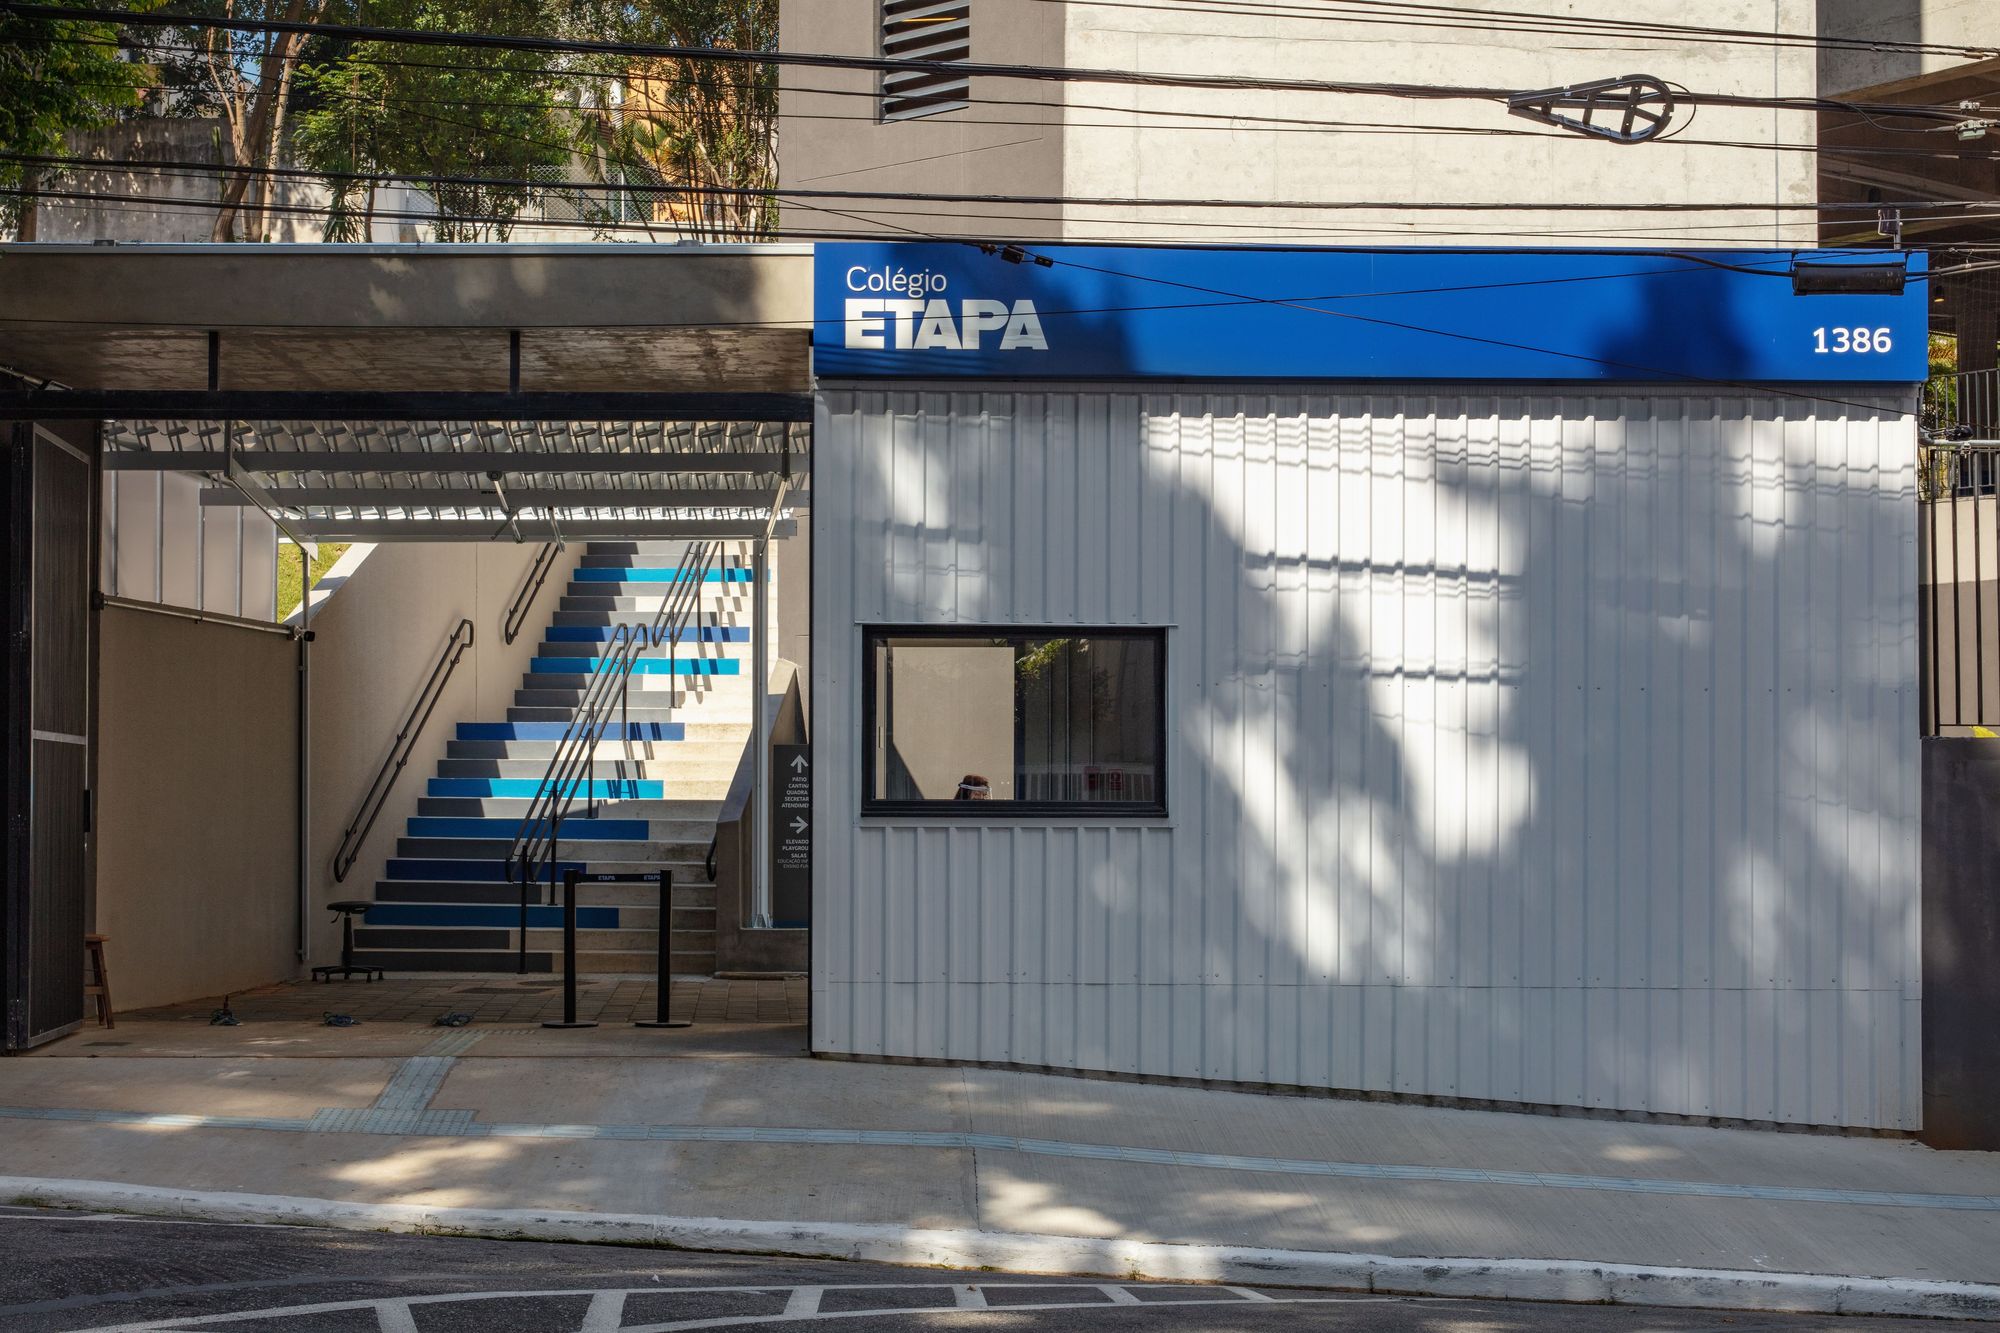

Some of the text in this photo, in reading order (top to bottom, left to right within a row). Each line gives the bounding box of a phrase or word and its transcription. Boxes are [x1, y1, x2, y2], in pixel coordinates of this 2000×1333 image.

[846, 265, 947, 298] Colégio
[844, 298, 1049, 350] ETAPA
[1813, 327, 1892, 353] 1386
